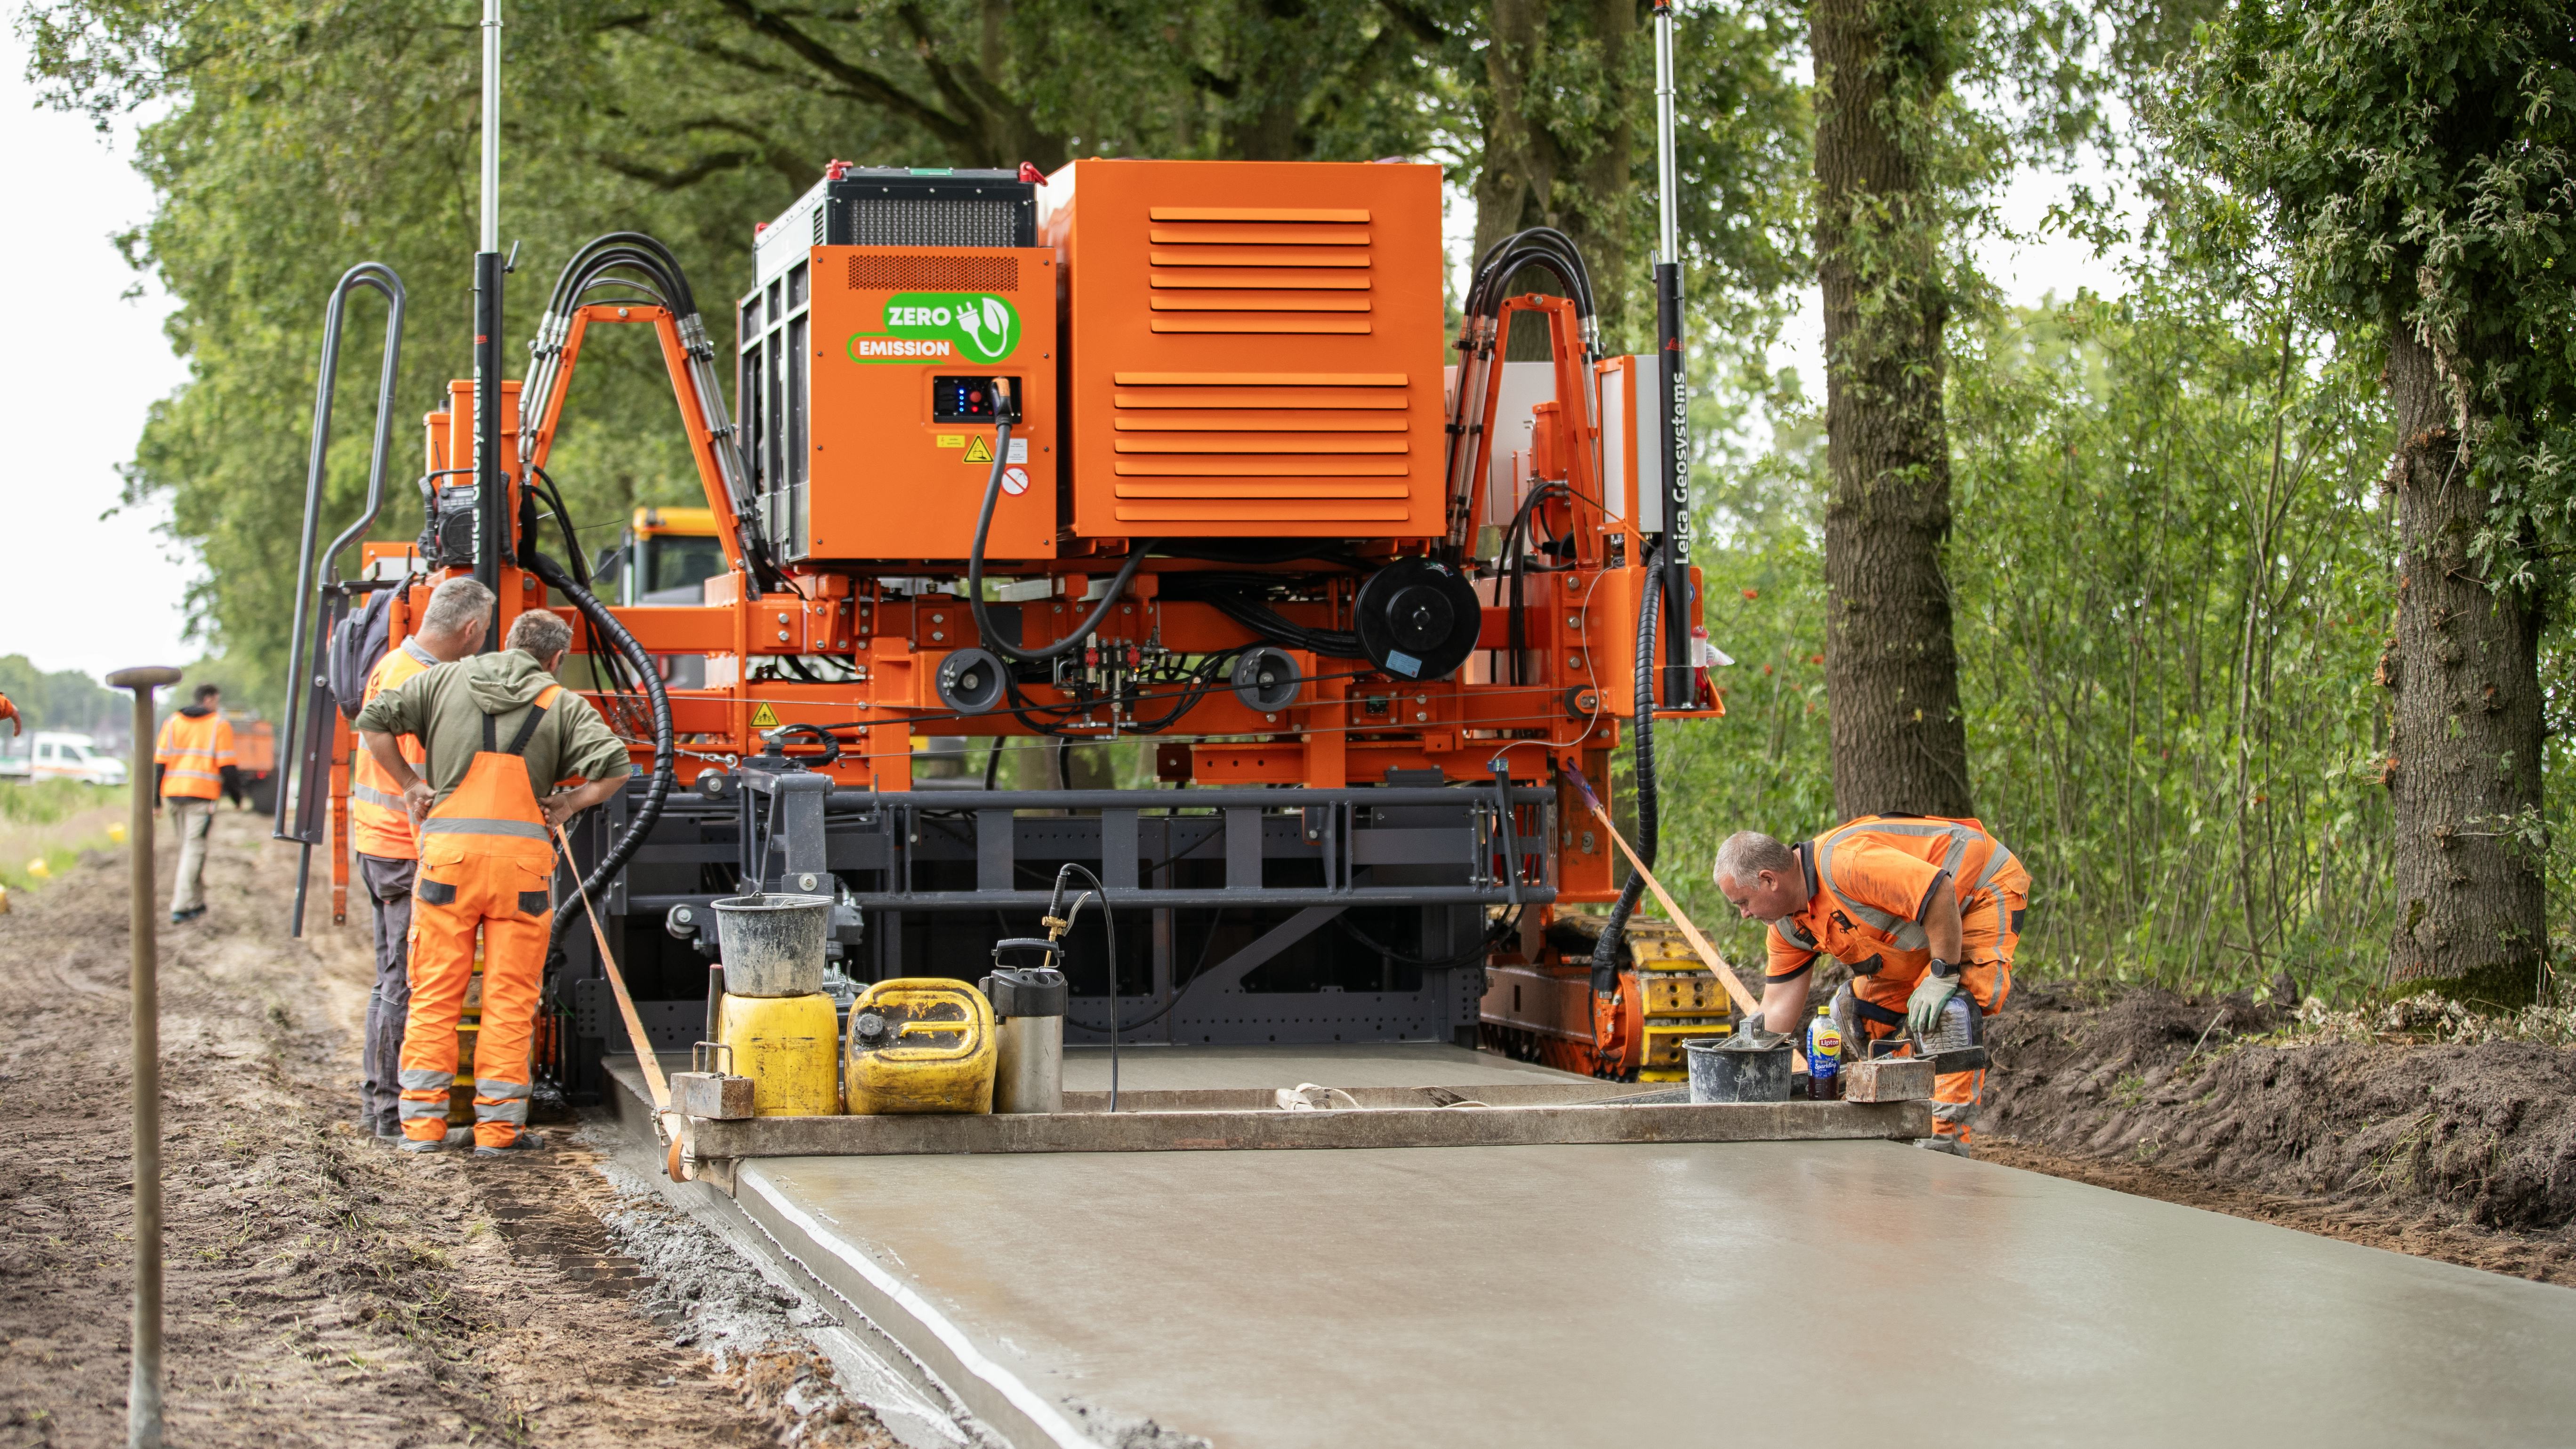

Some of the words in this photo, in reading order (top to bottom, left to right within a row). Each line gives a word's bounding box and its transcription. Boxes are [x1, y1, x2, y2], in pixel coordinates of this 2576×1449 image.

[888, 307, 951, 326] ZERO
[860, 341, 950, 356] EMISSION
[1672, 372, 1688, 503] Geosystems
[1673, 510, 1689, 564] Leica
[1815, 1062, 1836, 1071] Sparkling
